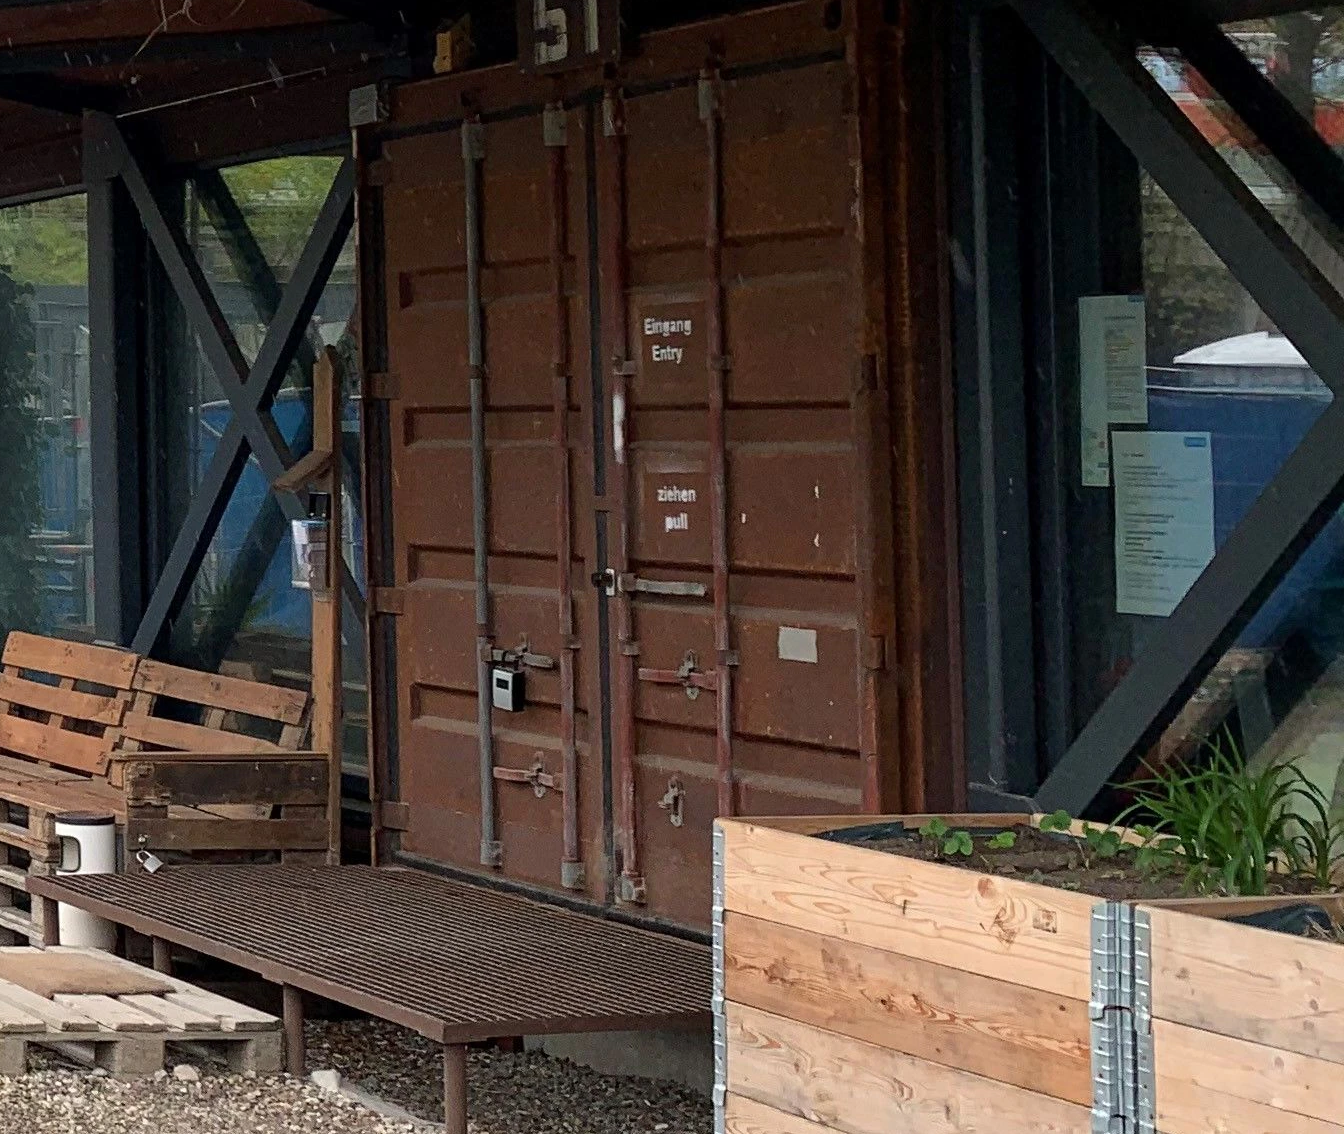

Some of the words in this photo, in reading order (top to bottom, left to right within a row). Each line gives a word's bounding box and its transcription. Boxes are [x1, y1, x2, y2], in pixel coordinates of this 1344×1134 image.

[644, 318, 692, 337] Eingang
[652, 345, 683, 364] Entry
[657, 486, 696, 502] ziehen
[665, 512, 688, 533] pull
